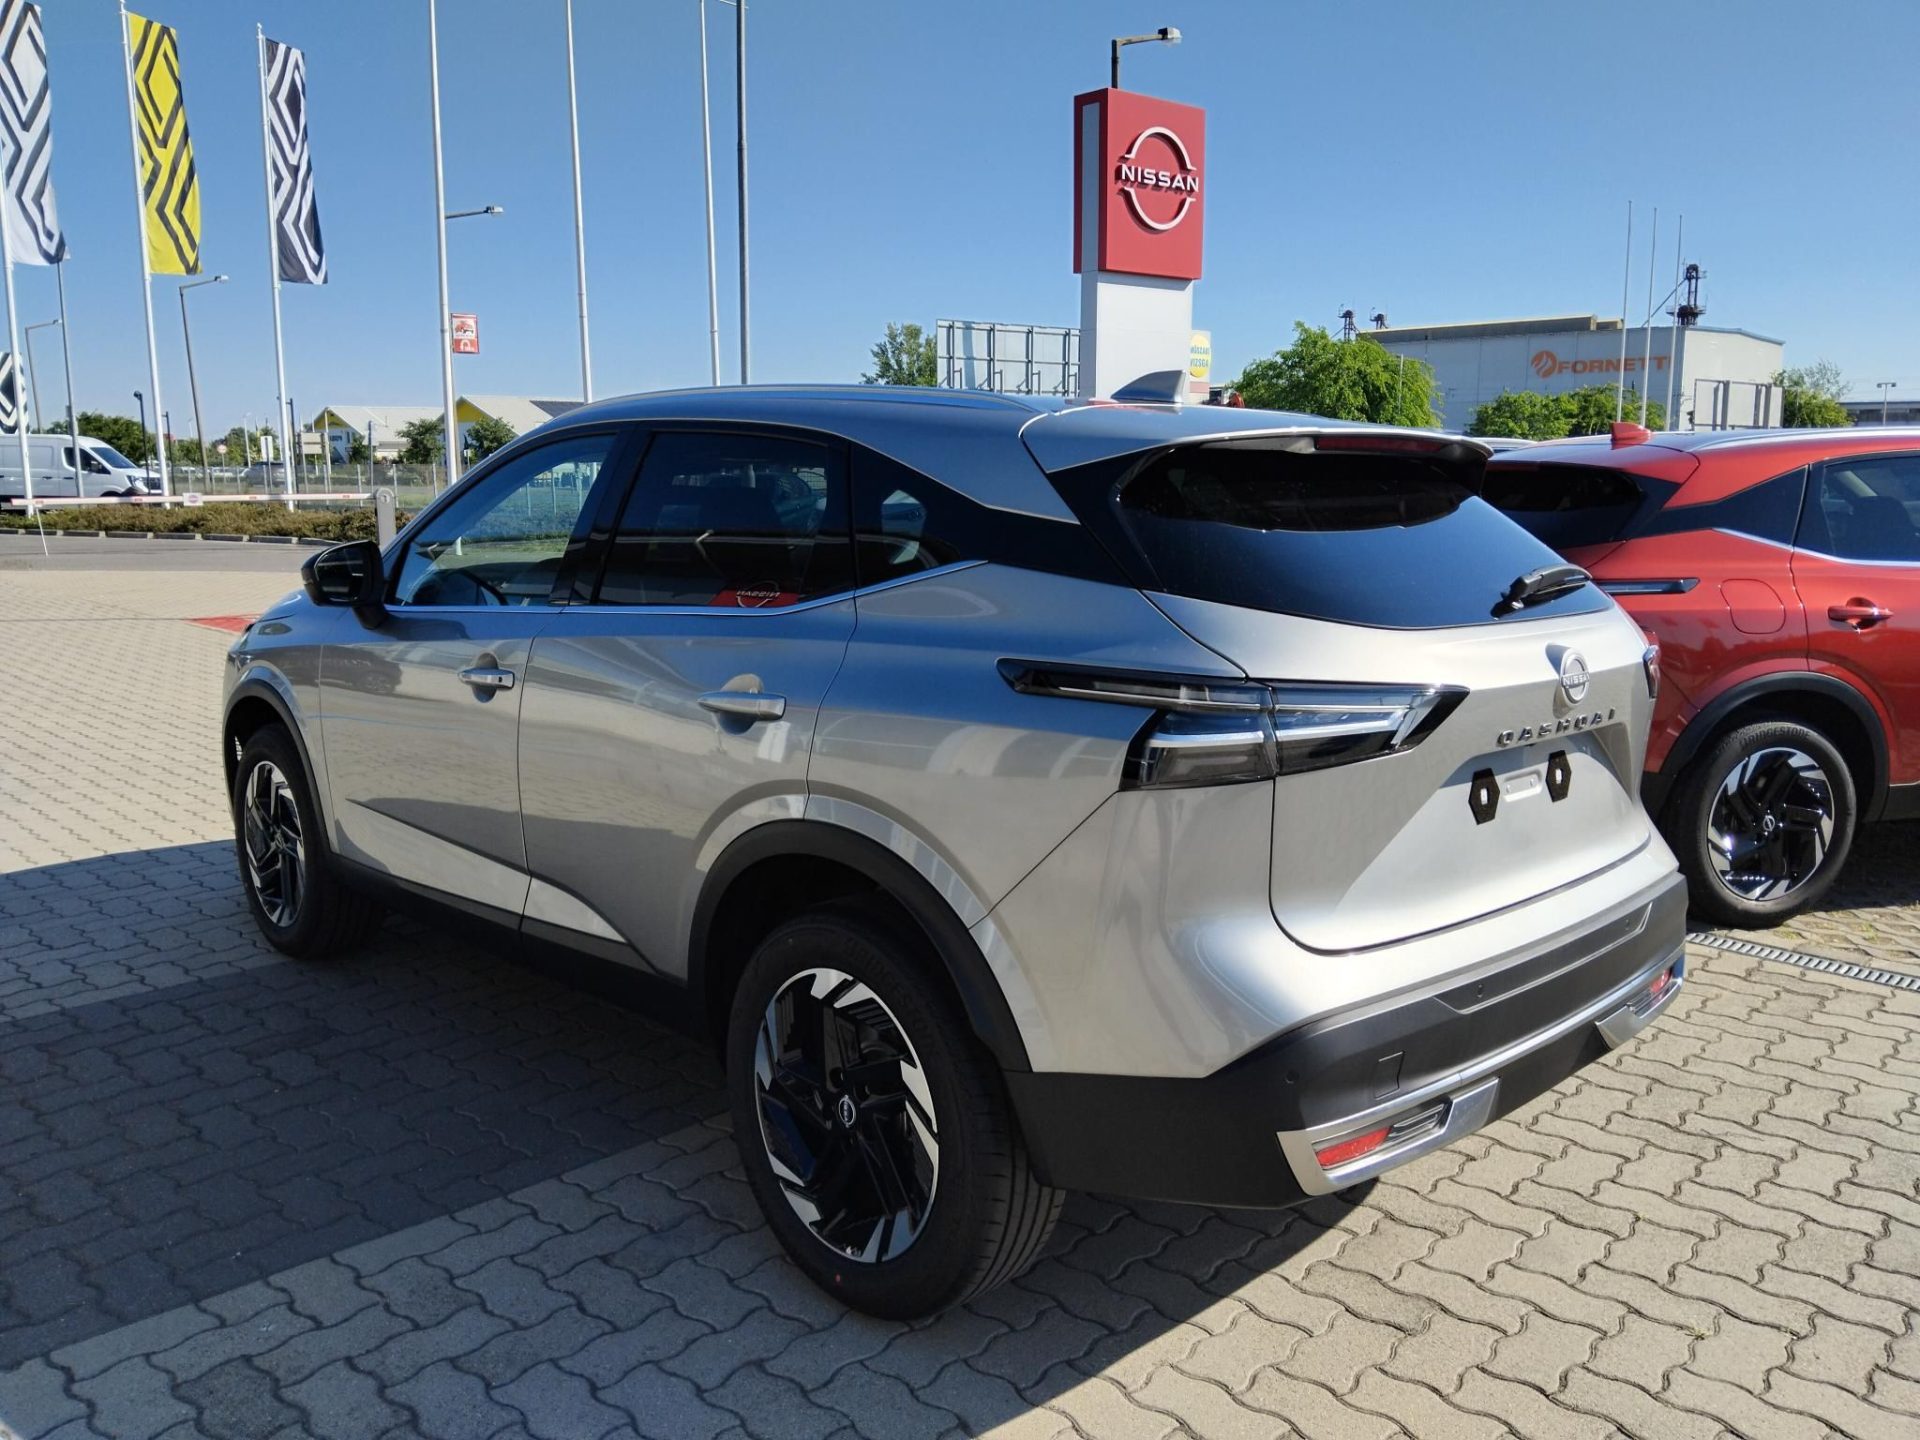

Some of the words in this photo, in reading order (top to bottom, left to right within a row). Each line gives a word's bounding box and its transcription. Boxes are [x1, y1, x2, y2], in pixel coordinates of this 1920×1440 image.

[1121, 164, 1199, 192] NISSAN
[1563, 672, 1590, 686] NISSAN
[1497, 707, 1616, 747] QASHQAI
[1739, 726, 1811, 748] BRIDGESTONE
